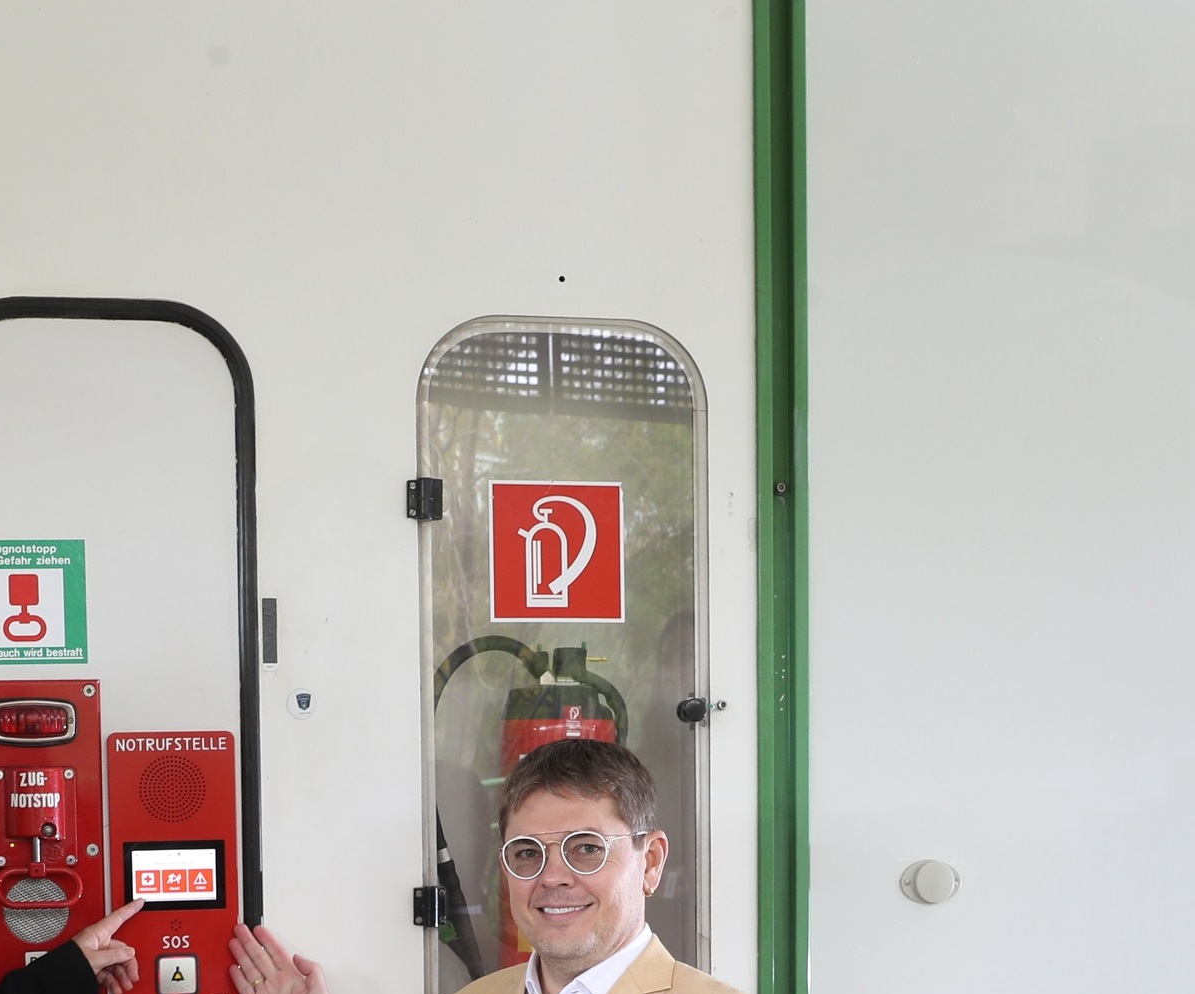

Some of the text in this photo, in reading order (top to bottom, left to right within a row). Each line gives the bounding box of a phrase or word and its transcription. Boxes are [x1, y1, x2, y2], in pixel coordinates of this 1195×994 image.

[36, 556, 71, 565] ziehen
[23, 648, 43, 657] wird
[46, 647, 83, 657] bestraft
[115, 737, 227, 752] NOTRUFSTELLE
[19, 771, 48, 787] ZUG-
[10, 792, 60, 808] NOTSTOP
[162, 935, 190, 949] SOS
